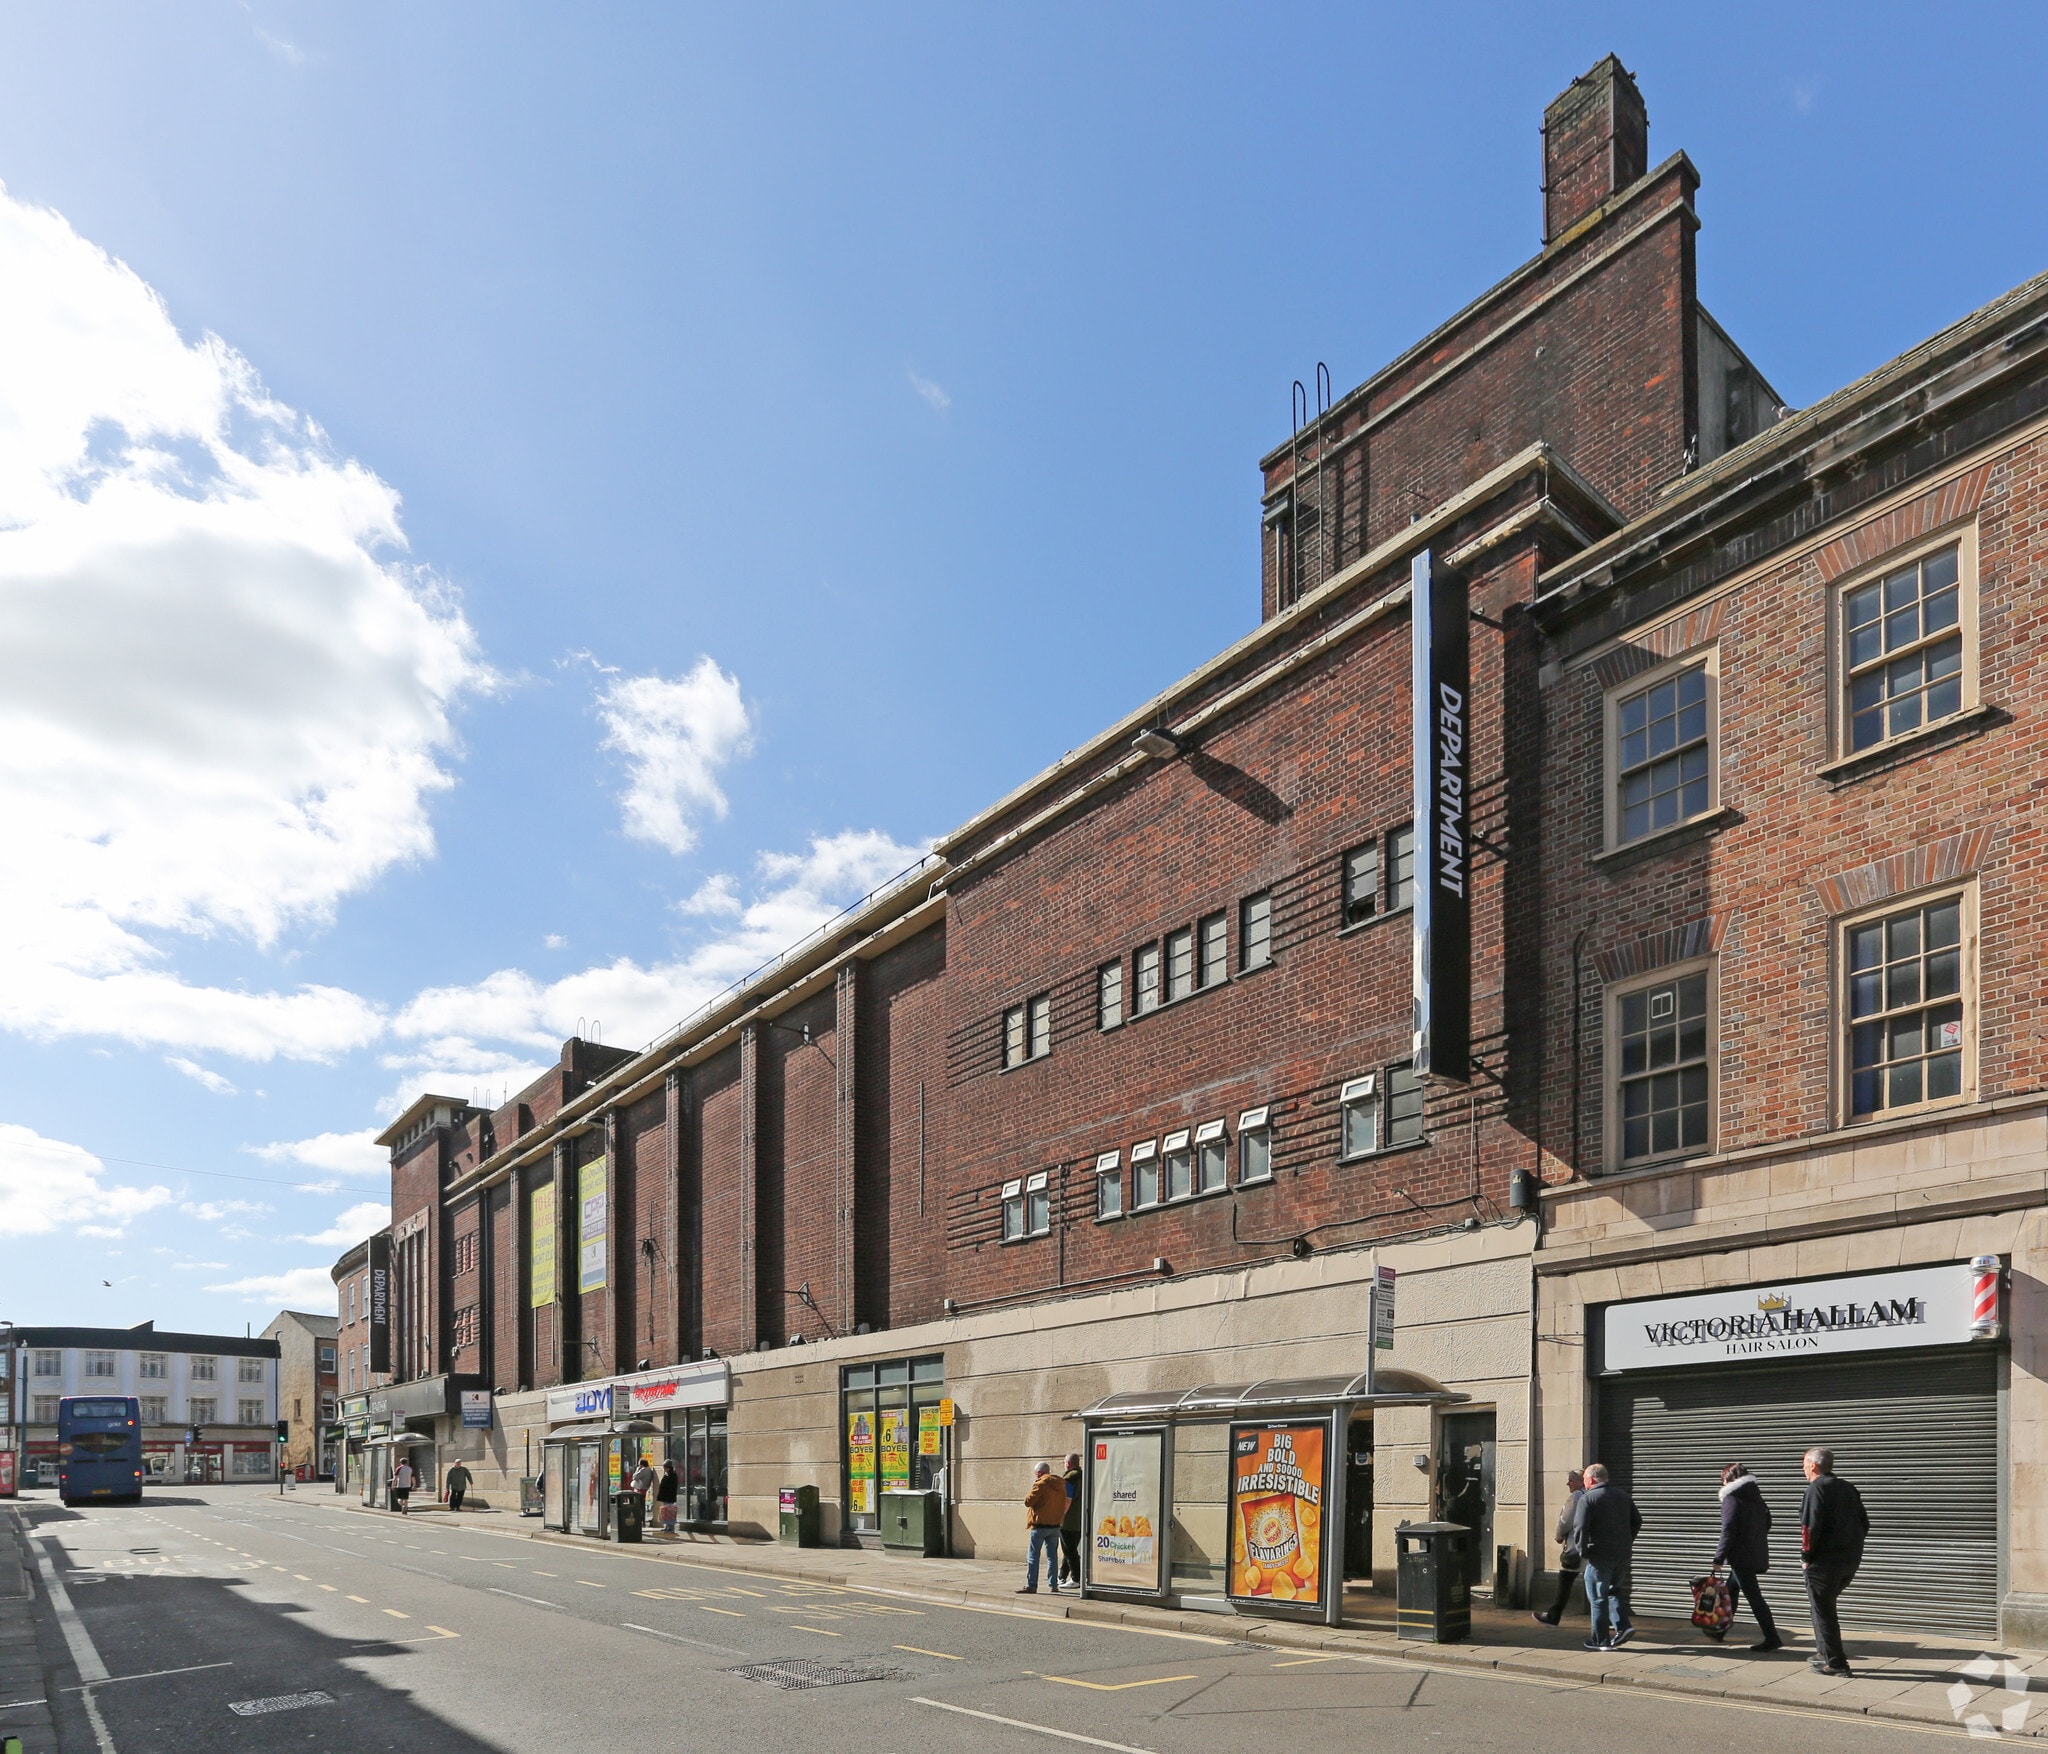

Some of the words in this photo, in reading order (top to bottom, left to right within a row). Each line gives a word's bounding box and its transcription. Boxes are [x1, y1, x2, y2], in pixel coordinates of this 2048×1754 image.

[1440, 682, 1463, 899] DEPARTMENT
[374, 1269, 386, 1325] DEPARTMENT
[1643, 1311, 1778, 1345] VICTORIA
[1781, 1297, 1919, 1331] HALLAM
[1726, 1341, 1763, 1355] HAIR
[1767, 1336, 1820, 1352] SALON
[881, 1445, 908, 1453] BOYES
[1237, 1440, 1256, 1451] NEW
[1273, 1433, 1293, 1450] BIG
[1267, 1448, 1296, 1465] BOLD
[1257, 1463, 1274, 1474] AND
[1113, 1490, 1136, 1499] shared
[1237, 1473, 1320, 1506] IRRESISTIBLE
[1097, 1536, 1110, 1548] 20
[1110, 1541, 1136, 1550] Chicken
[1249, 1533, 1299, 1561] FLAVARINGS
[103, 1554, 206, 1569] BUS
[1098, 1555, 1126, 1564] Sharebox
[73, 1561, 261, 1585] STAD
